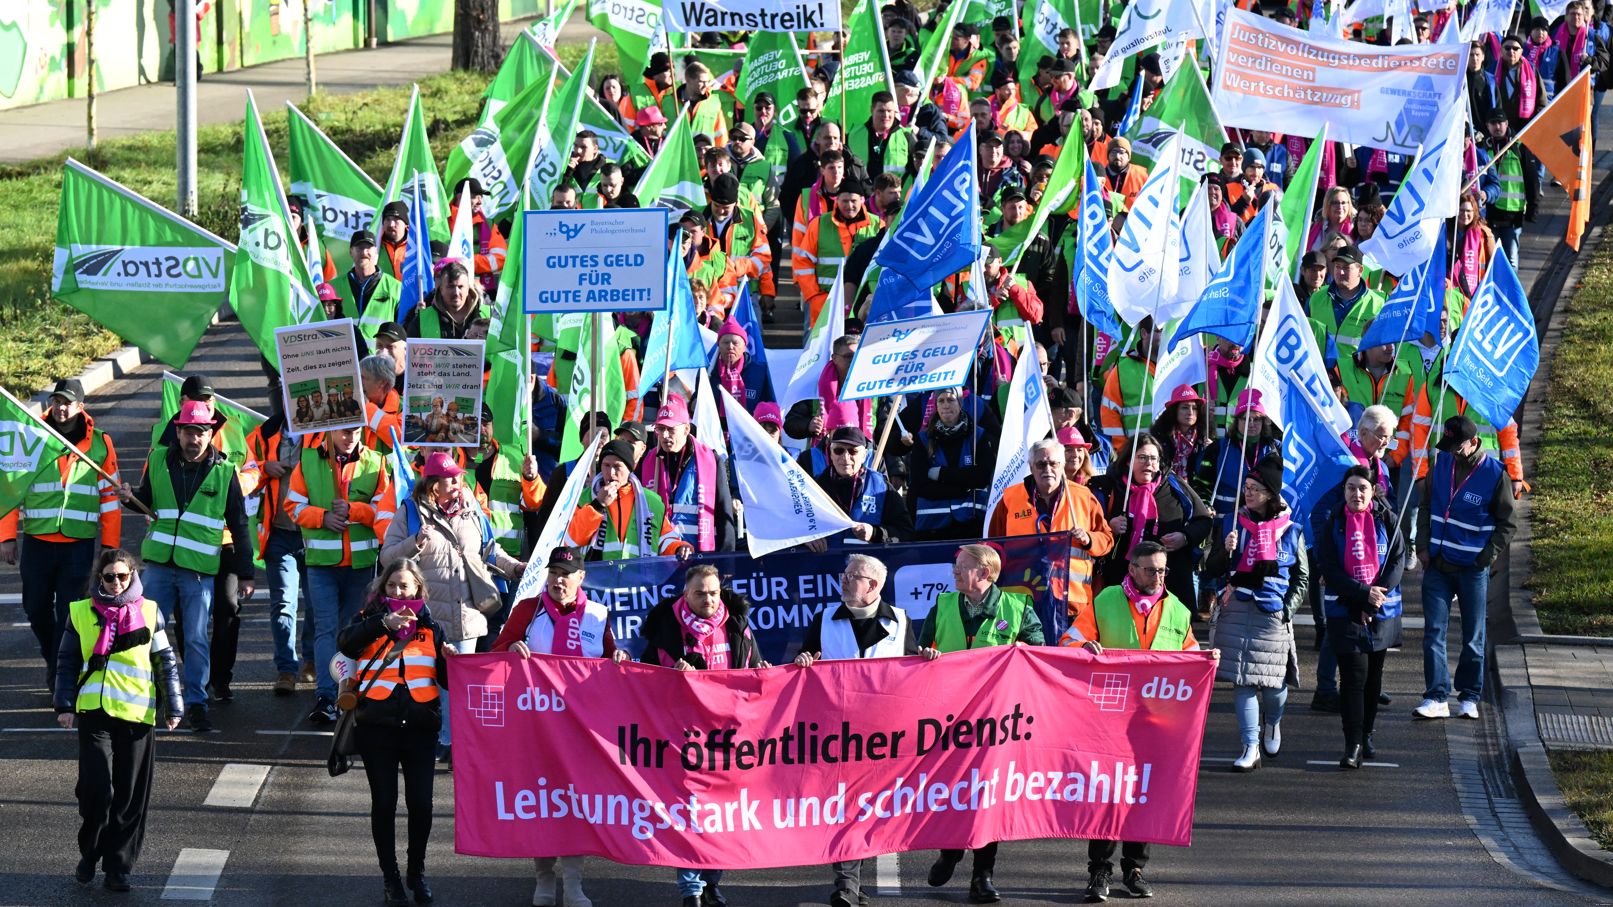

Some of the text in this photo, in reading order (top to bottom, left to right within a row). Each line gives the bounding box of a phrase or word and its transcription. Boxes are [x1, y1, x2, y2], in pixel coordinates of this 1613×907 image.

[681, 2, 825, 30] Warnstreik!
[1232, 26, 1456, 70] Justizvollzugsbedienstete
[1229, 50, 1314, 81] verdienen
[1225, 71, 1360, 107] Wertschätzung!
[546, 253, 645, 269] GUTES GELD
[578, 270, 612, 286] FÜR
[538, 287, 651, 304] GUTE ARBEIT!
[1471, 294, 1523, 360] BLLV
[872, 345, 958, 365] GUTES GELD
[1096, 336, 1107, 361] dbb
[303, 363, 317, 371] dies
[328, 358, 352, 367] zeigen!
[895, 362, 925, 376] FÜR
[856, 370, 956, 393] GUTE ARBEIT!
[1465, 493, 1480, 503] BLLV
[1351, 531, 1364, 560] dbb
[566, 617, 581, 650] dbb
[517, 687, 566, 712] dbb
[1141, 676, 1193, 702] dbb
[618, 703, 1034, 772] Ihr öffentlicher Dienst:
[494, 760, 1152, 840] Leistungsstark und schlecht bezahlt!
